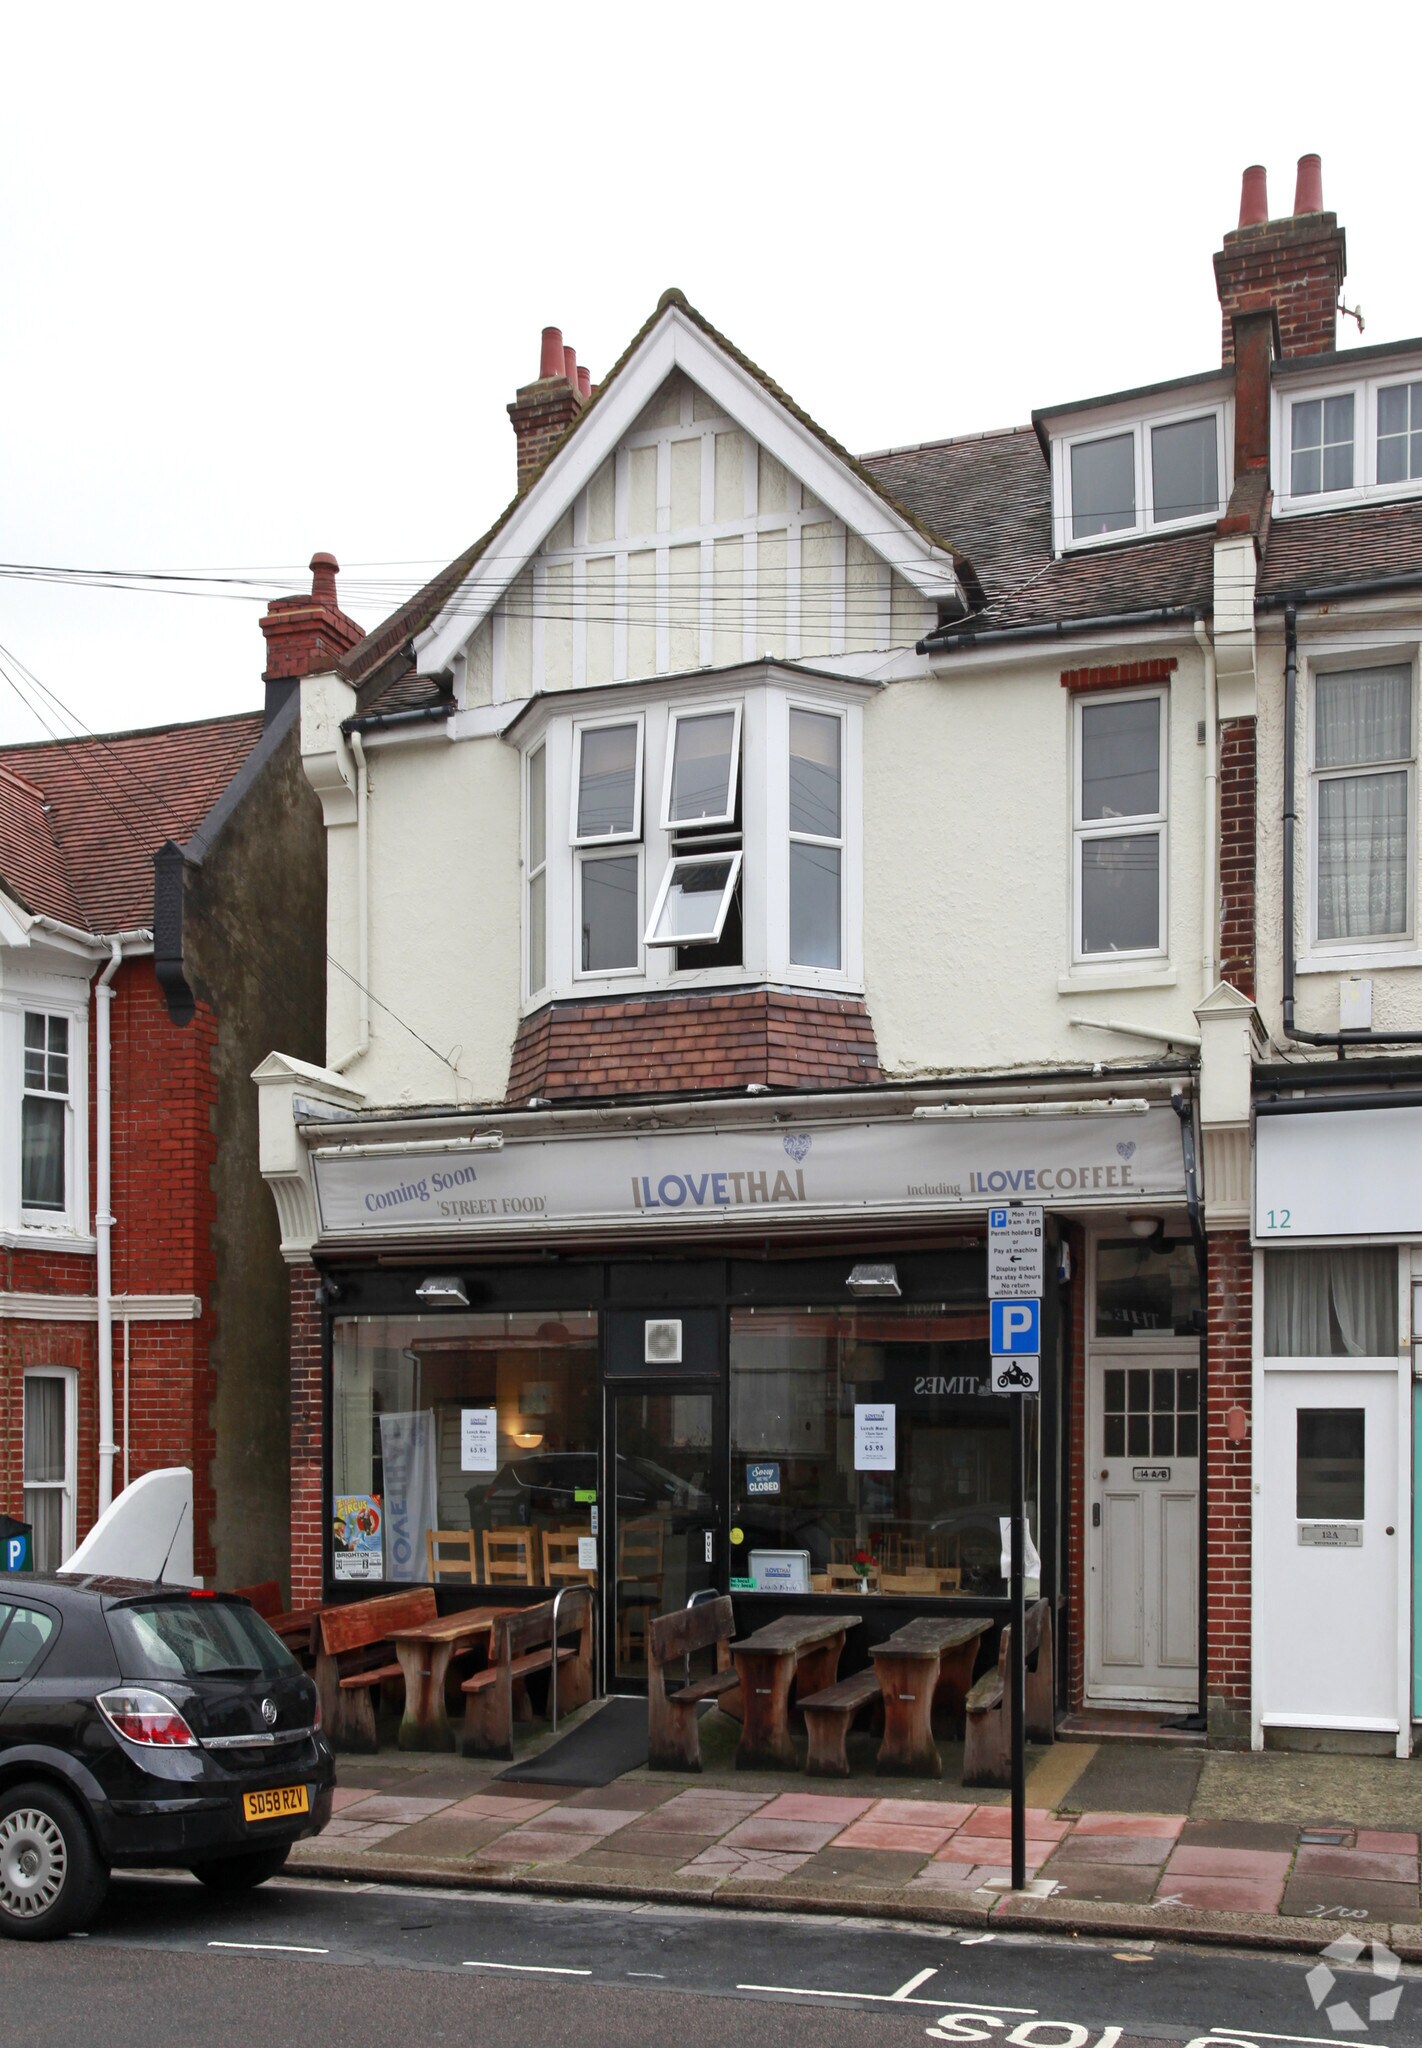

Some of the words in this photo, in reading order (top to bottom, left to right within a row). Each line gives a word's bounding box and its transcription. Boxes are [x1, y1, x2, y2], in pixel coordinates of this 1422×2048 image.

[364, 1179, 431, 1212] Coming
[431, 1166, 477, 1192] Soon
[631, 1169, 807, 1208] ILOVETHAI
[906, 1183, 961, 1197] Including
[969, 1165, 1135, 1193] ILOVECOFFEE
[994, 1212, 1005, 1227] P
[1267, 1209, 1291, 1229] 12
[1002, 1306, 1032, 1350] P
[752, 1466, 774, 1479] Sorry
[749, 1482, 779, 1492] CLOSED
[337, 1499, 367, 1521] CIRCUS
[1322, 1531, 1339, 1539] 12A
[9, 1540, 21, 1567] P
[249, 1791, 281, 1815] SD58
[282, 1788, 302, 1810] RZV
